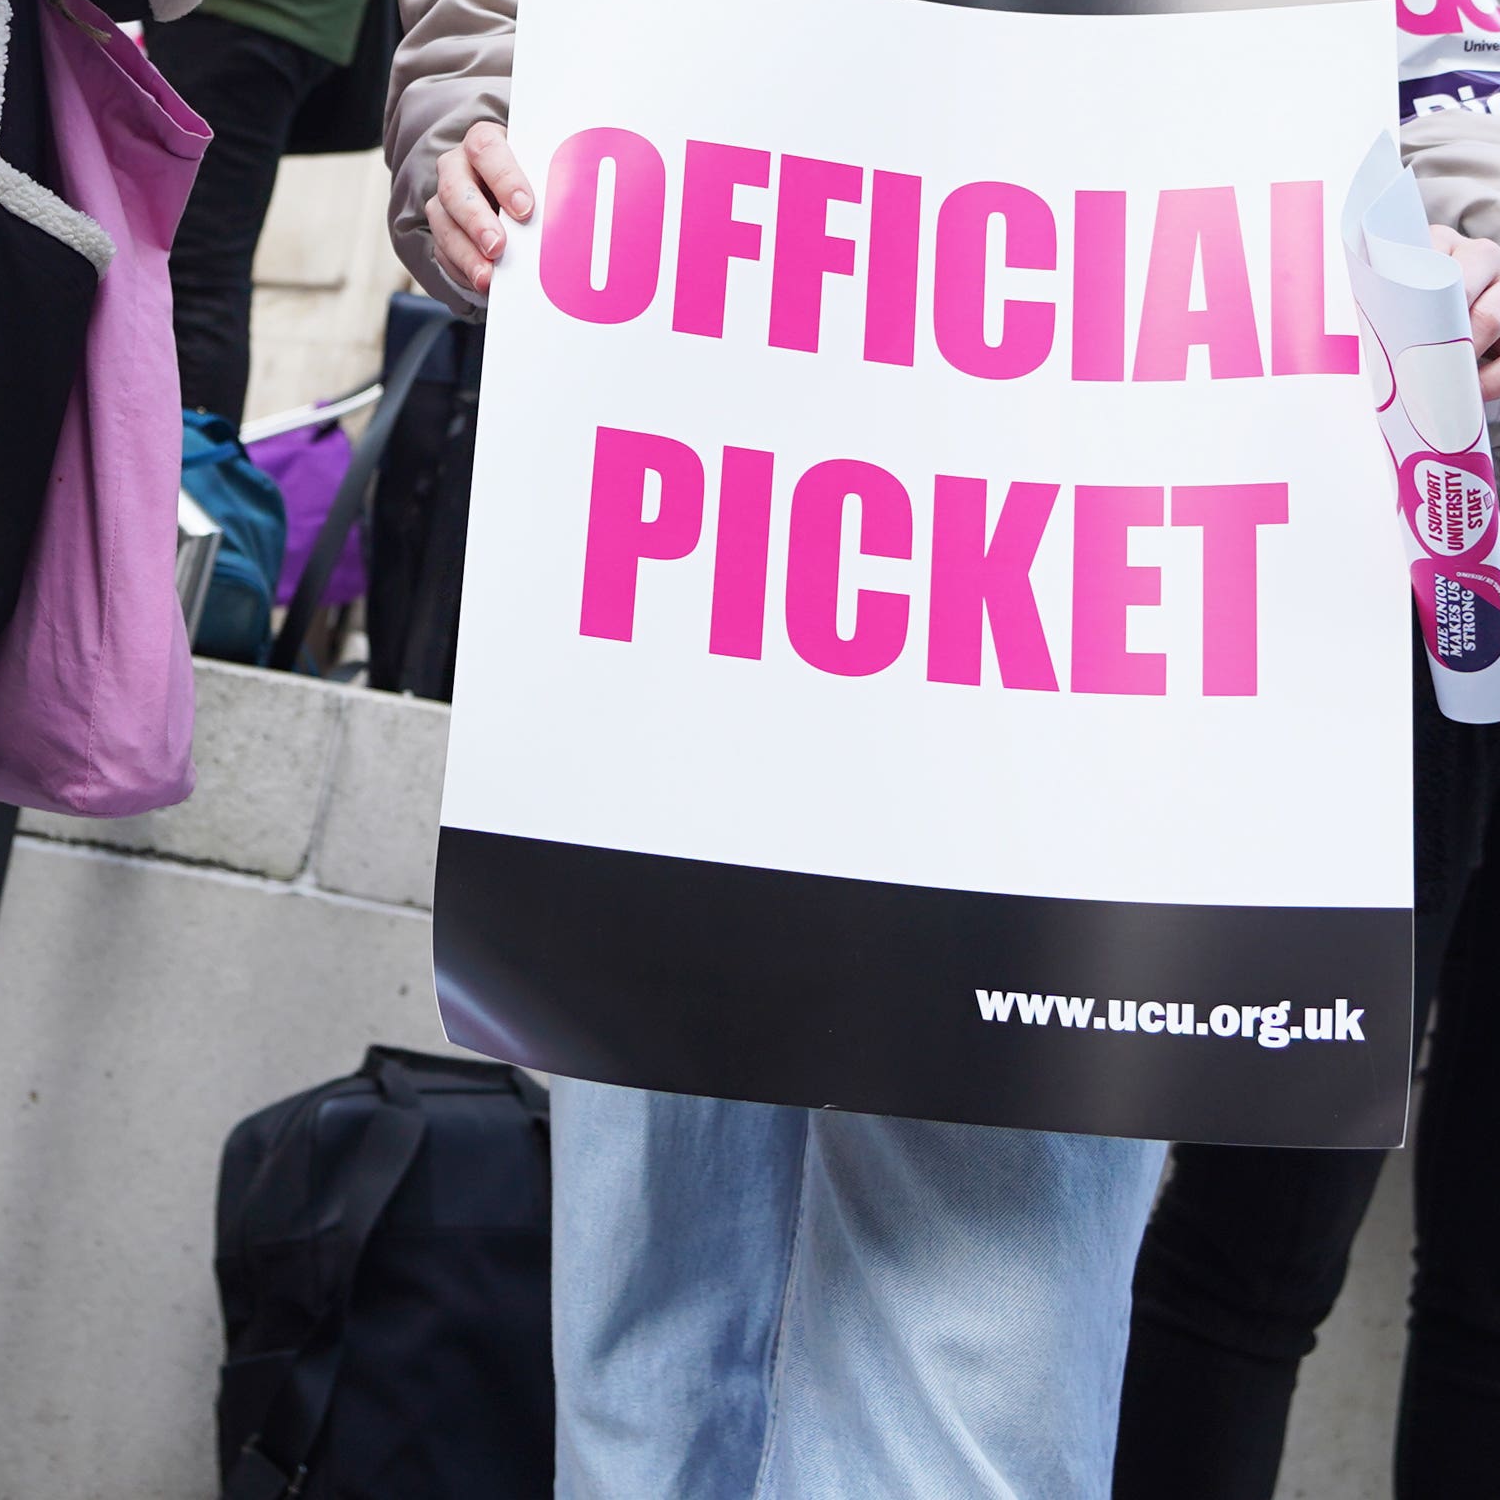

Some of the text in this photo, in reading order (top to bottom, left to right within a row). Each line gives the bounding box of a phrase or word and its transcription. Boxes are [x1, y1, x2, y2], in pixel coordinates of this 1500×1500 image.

[538, 126, 1360, 382] OFFICIAL
[1427, 470, 1443, 542] I SUPPORT
[1445, 470, 1464, 551] UNIVERSITY
[1467, 488, 1483, 530] STAFF
[579, 426, 1289, 697] PICKET
[1434, 573, 1449, 657] THE UNION
[1447, 580, 1462, 658] MAKES US
[1461, 589, 1476, 652] STRONG
[975, 988, 1365, 1048] www.ucu.org.uk
